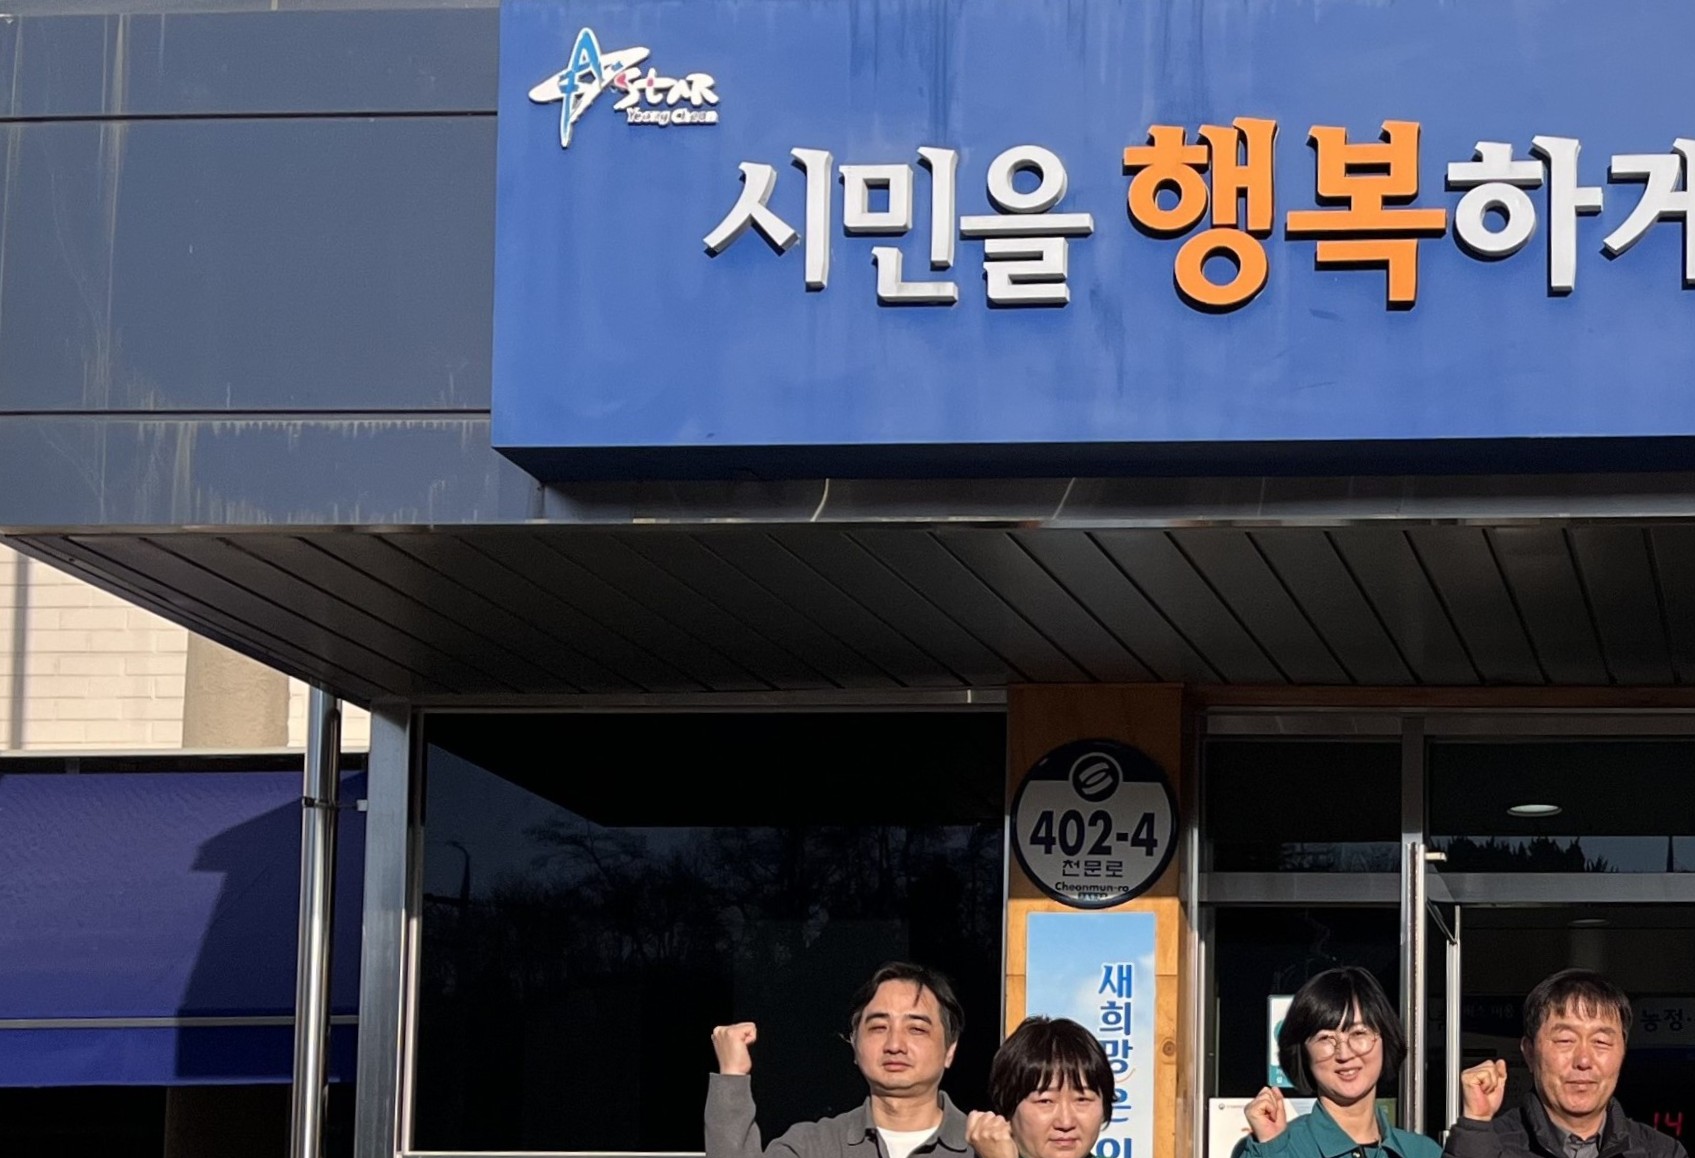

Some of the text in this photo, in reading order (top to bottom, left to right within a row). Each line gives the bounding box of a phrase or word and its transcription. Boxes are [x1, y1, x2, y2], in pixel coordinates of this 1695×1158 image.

[705, 145, 1094, 306] 시민을
[1030, 809, 1158, 856] 402-4
[1063, 860, 1123, 877] 천문로
[1055, 882, 1129, 891] Cheonmun-ro
